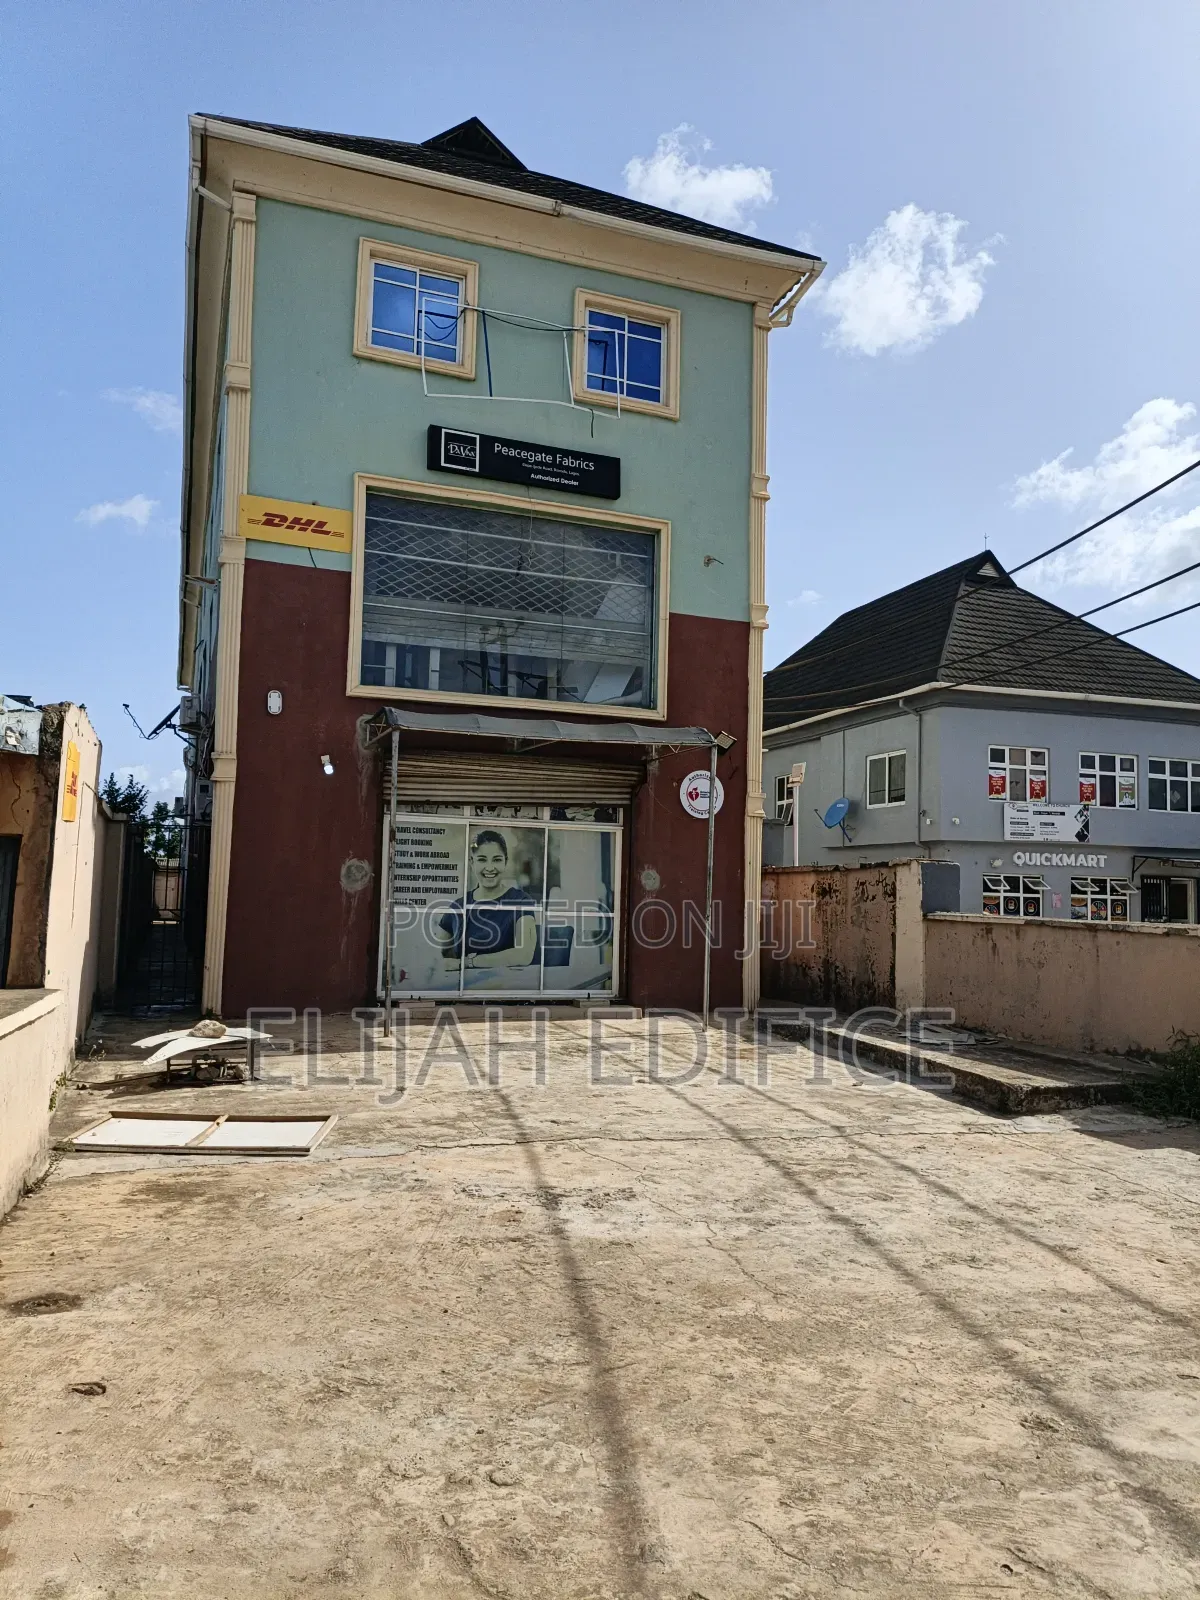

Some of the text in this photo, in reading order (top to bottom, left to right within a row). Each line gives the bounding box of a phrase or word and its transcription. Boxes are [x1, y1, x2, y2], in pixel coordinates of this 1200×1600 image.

[494, 442, 595, 471] Peacegate Fabrics
[530, 473, 579, 486] Authorized Dealer
[260, 512, 332, 536] DHL
[412, 827, 446, 835] CONSULTANCY
[410, 839, 433, 847] BOOKING
[430, 851, 450, 859] ABROAD
[1012, 851, 1108, 868] QUICKMART
[421, 863, 458, 871] EMPOWERMENT
[394, 874, 459, 883] NTERNSHIP OPPORTUNITIES
[421, 887, 458, 895] EMPLOYABILITY
[408, 898, 427, 906] CENTER
